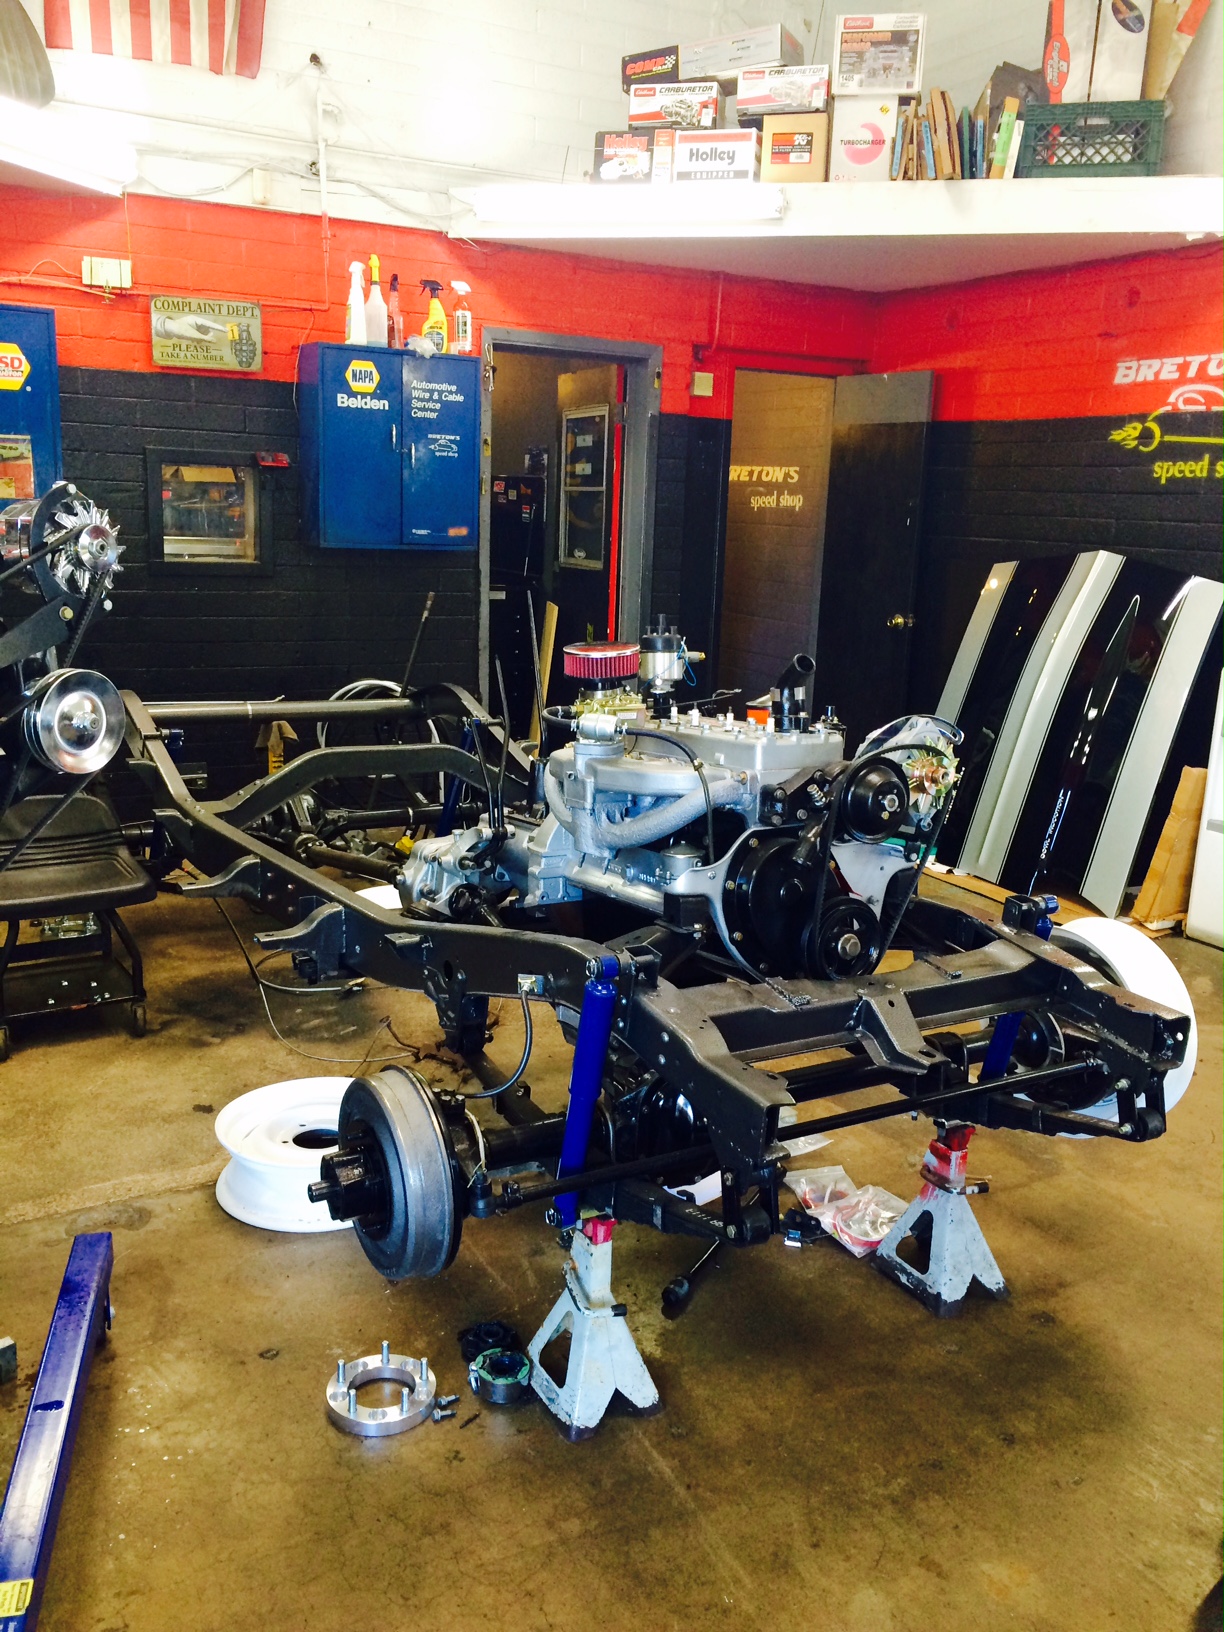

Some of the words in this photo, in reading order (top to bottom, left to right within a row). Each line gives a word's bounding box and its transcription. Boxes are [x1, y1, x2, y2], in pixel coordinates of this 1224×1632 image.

[626, 56, 665, 75] COMP
[768, 67, 825, 76] CARBURETOR
[659, 85, 714, 93] CARBURETOR
[604, 133, 649, 151] Holley
[689, 147, 736, 165] Holley
[691, 170, 734, 179] EQUIPPED
[154, 298, 224, 315] COMPLAINT
[227, 304, 258, 318] DEPT.
[172, 343, 212, 354] PLEASE
[192, 354, 225, 362] NUMBER
[351, 368, 375, 385] NAPA
[411, 380, 457, 392] Automotive
[337, 393, 389, 410] Belden
[411, 390, 430, 399] Wire
[432, 391, 439, 400] &
[441, 392, 465, 402] Cable
[411, 399, 441, 410] Service
[411, 409, 438, 419] Center
[1154, 453, 1209, 485] speed
[750, 490, 777, 511] speed
[779, 490, 803, 511] shop
